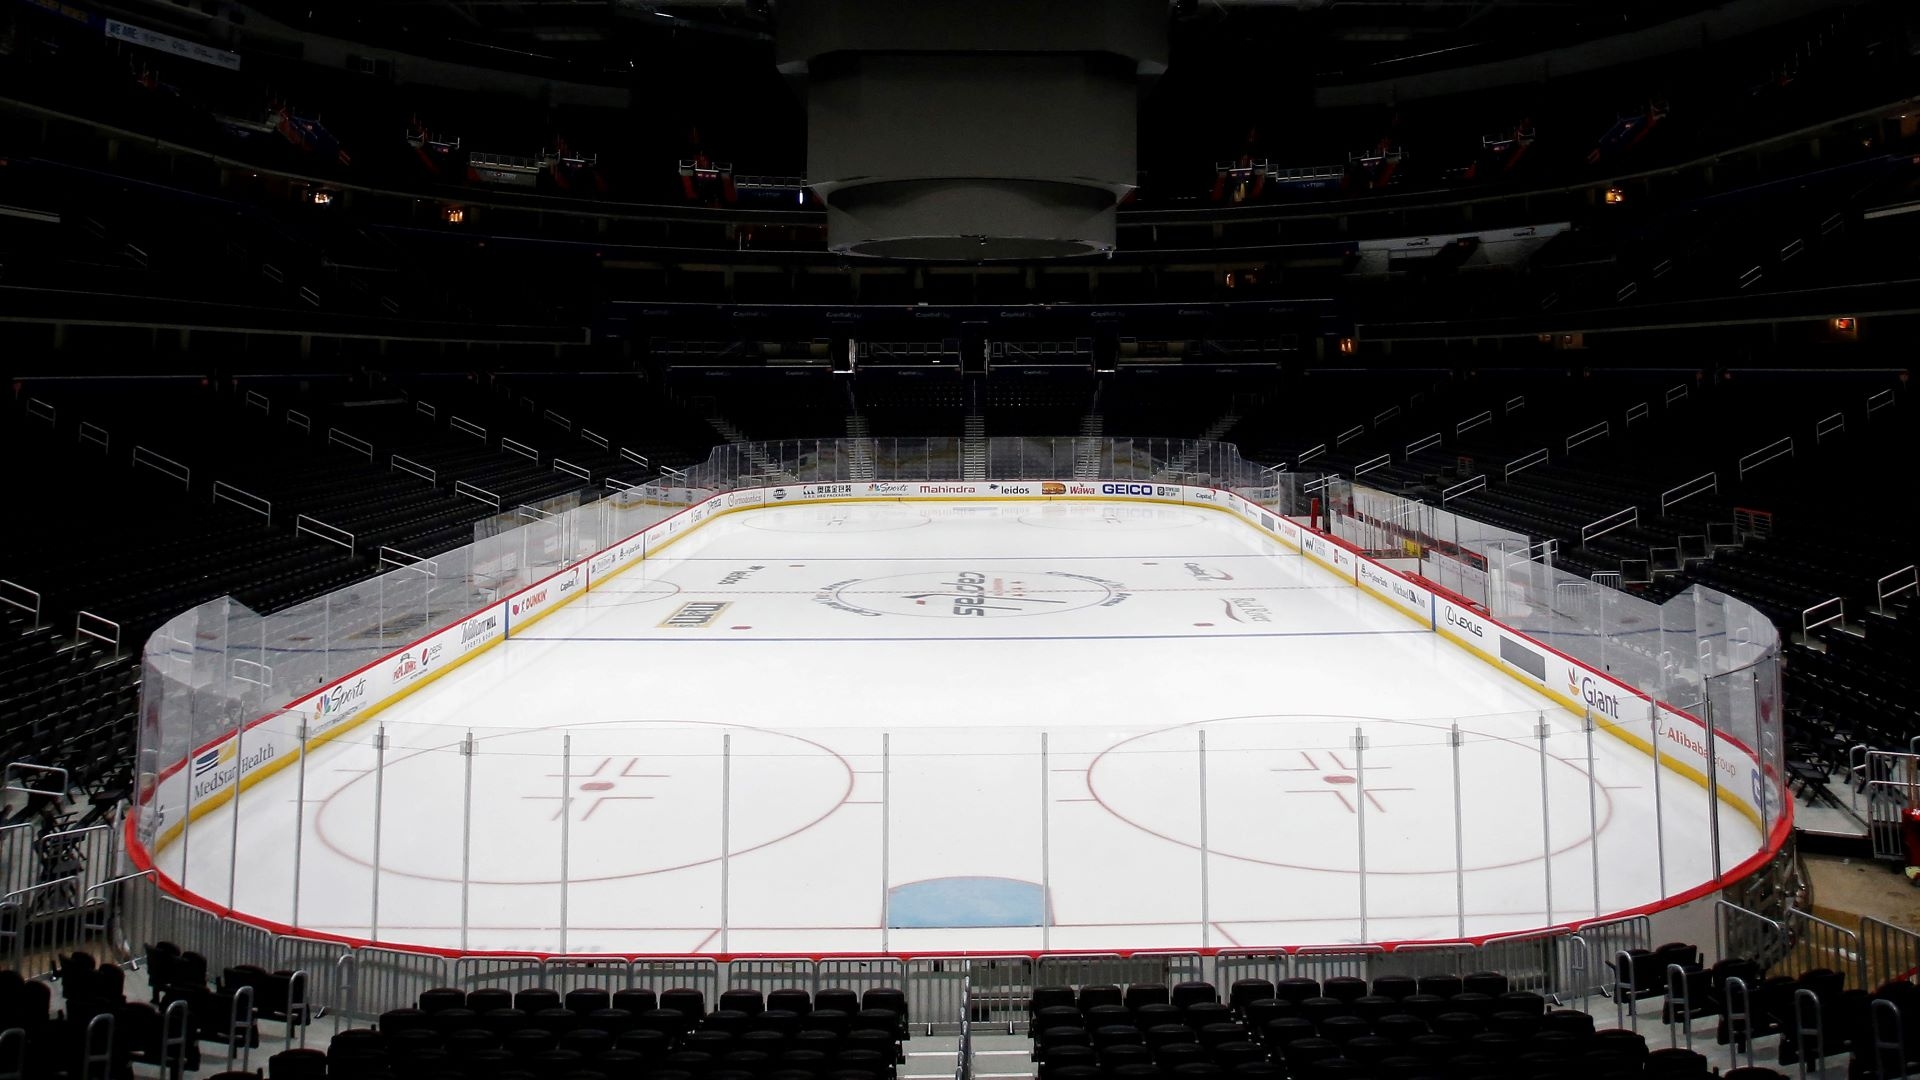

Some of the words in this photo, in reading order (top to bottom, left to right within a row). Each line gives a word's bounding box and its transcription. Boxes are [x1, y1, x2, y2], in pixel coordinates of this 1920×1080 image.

[879, 482, 908, 493] Sports
[919, 485, 976, 494] Mahindra
[1001, 485, 1030, 495] leidos
[1069, 485, 1096, 495] Wawa
[1102, 483, 1153, 496] GEICO
[1454, 613, 1483, 638] LEXUS
[331, 677, 367, 712] Sports
[1581, 675, 1619, 720] Giant
[1667, 727, 1708, 759] Alibaba
[1713, 751, 1736, 778] roup
[194, 766, 237, 801] MedStar
[241, 743, 274, 774] Health
